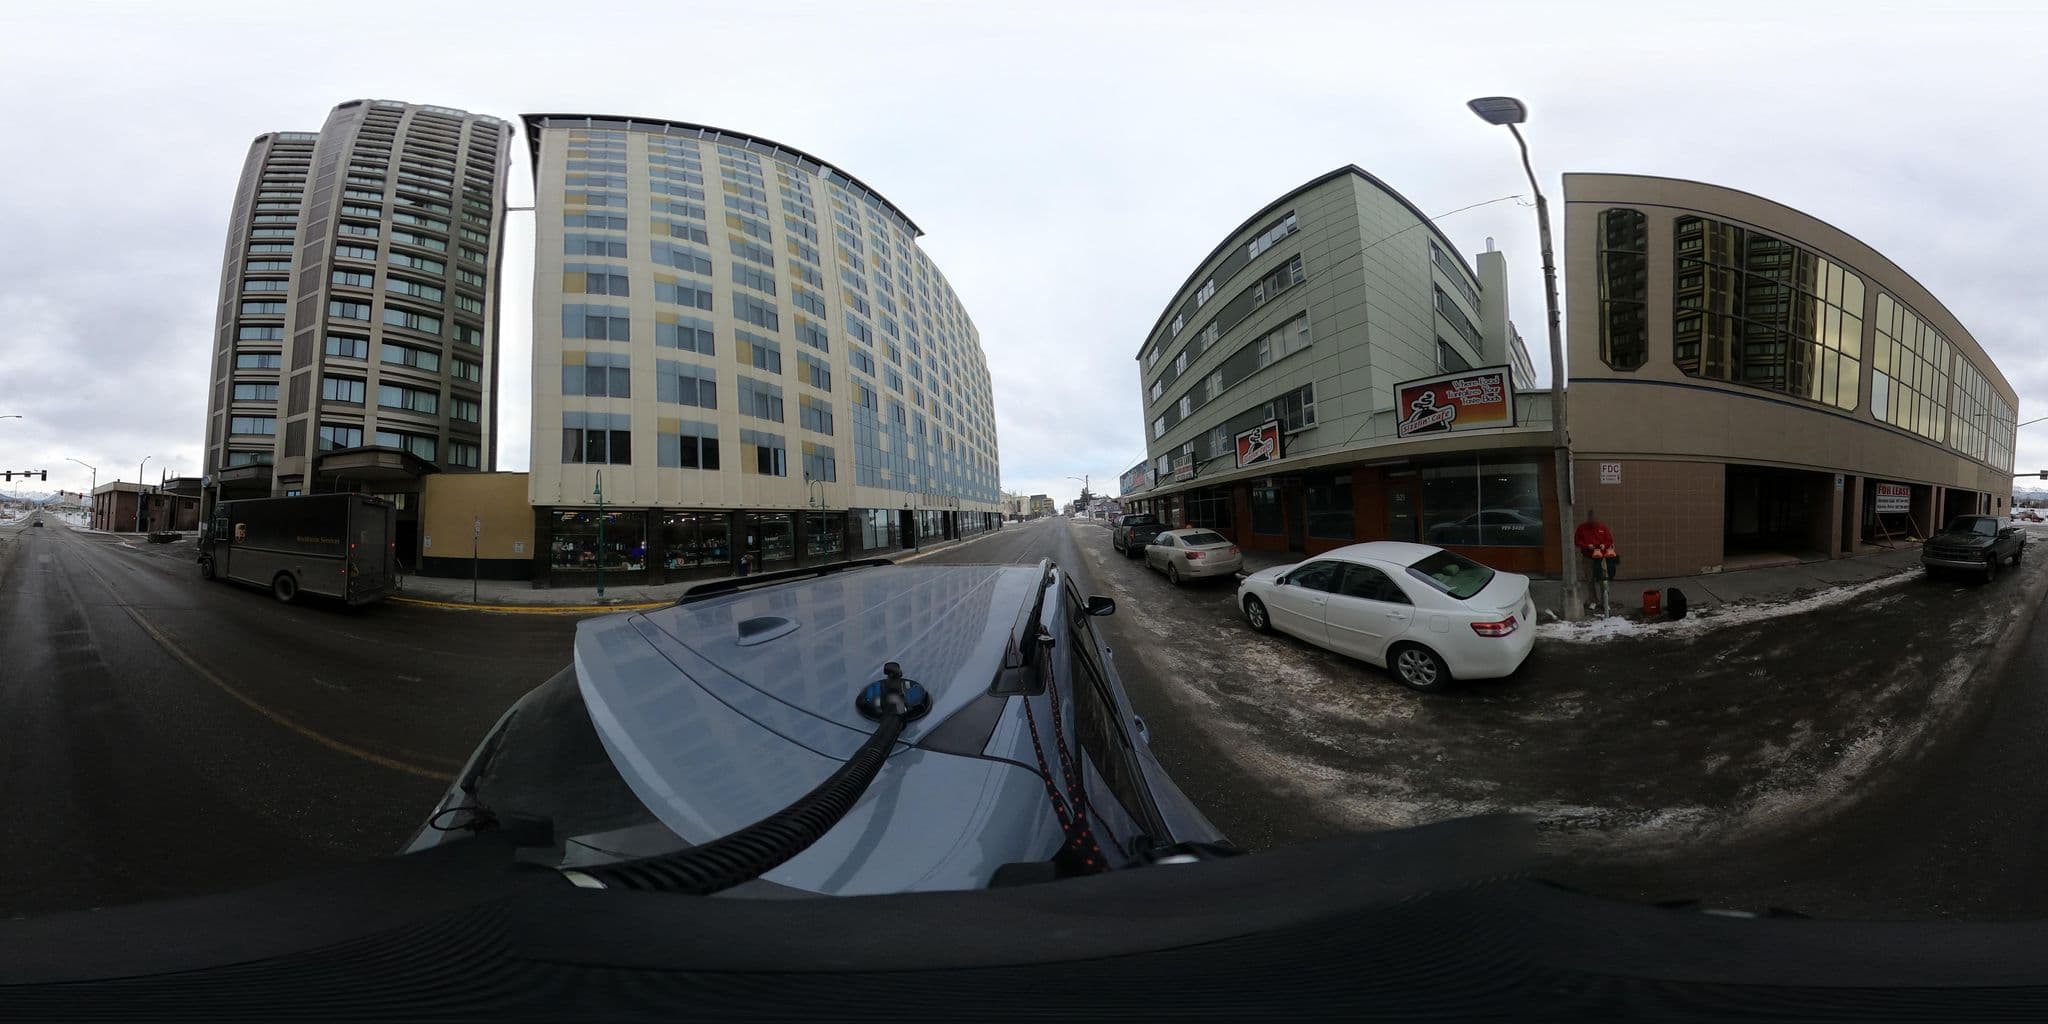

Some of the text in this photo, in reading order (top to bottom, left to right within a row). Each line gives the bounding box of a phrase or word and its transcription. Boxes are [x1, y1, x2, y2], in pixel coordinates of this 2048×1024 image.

[1602, 465, 1619, 473] FDC
[1878, 486, 1909, 496] FOR LEASE
